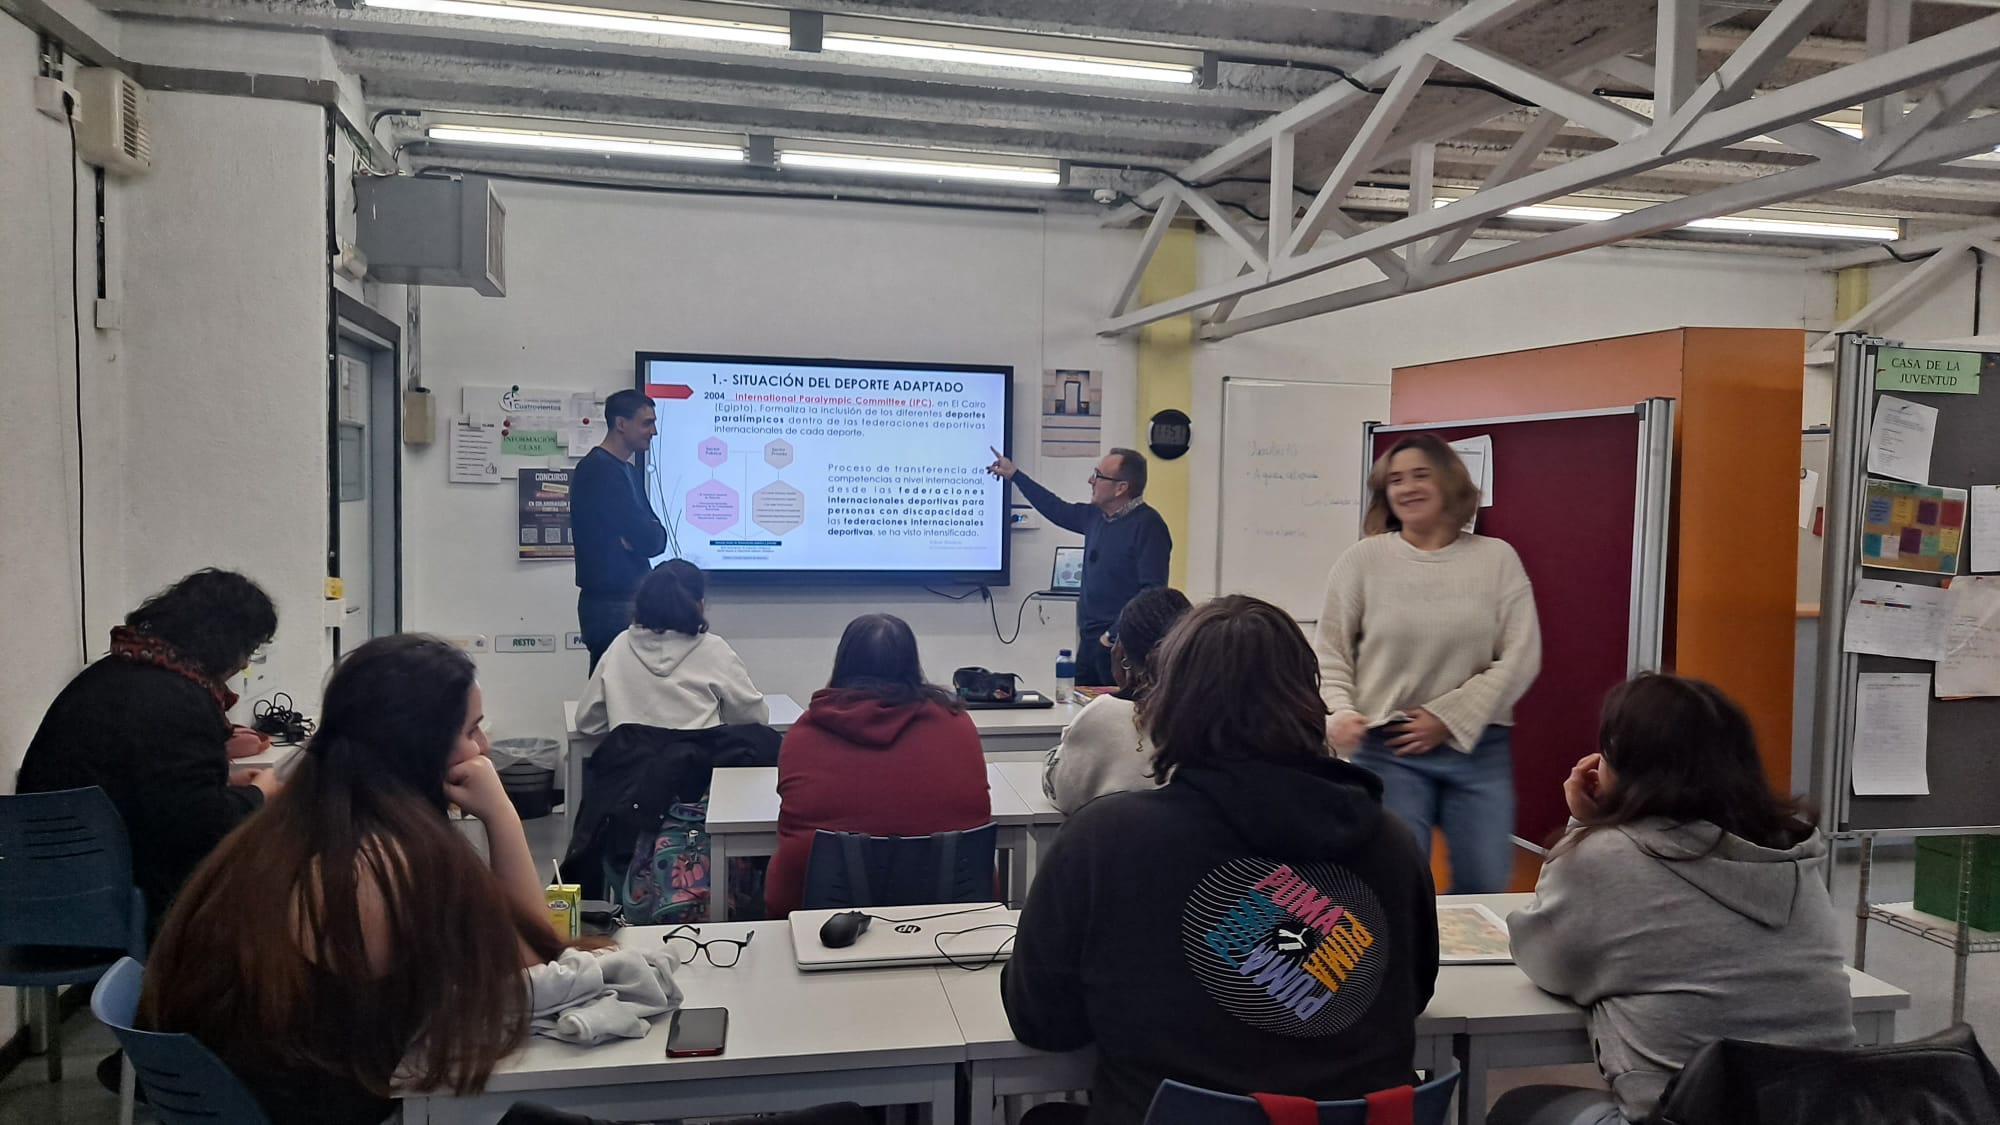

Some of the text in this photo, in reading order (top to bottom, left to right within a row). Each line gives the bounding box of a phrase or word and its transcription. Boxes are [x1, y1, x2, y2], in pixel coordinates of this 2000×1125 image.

[1891, 358, 1960, 372] CASA DE LA
[712, 373, 964, 392] 1.- SITUACIÓN DEL DEPORTE ADAPTADO
[1900, 373, 1958, 386] JUVENTUD
[704, 392, 725, 400] 2004
[736, 393, 796, 402] International
[800, 395, 852, 405] Paralympic
[856, 397, 906, 406] Committee
[962, 400, 986, 408] Cairo
[514, 402, 561, 412] Cuatrovientos
[760, 404, 806, 414] Formaliza
[809, 406, 818, 414] la
[820, 406, 862, 416] inclusión
[865, 408, 878, 416] de
[880, 408, 893, 416] los
[896, 409, 942, 418] diferentes
[945, 410, 986, 420] deportes
[714, 414, 986, 430] paralímpicos dentro de las federaciones deportivas
[714, 424, 865, 438] internacionales de cada deporte.
[828, 464, 984, 474] Proceso de transferencia de
[535, 473, 568, 481] CONCURSO
[828, 474, 892, 484] competencias
[903, 476, 924, 484] nivel
[828, 486, 984, 496] desde las federaciones
[828, 496, 984, 507] internacionales deportivas para
[828, 508, 875, 516] personas
[903, 508, 974, 517] discapacidad
[828, 517, 984, 528] las federaciones internacionales
[890, 529, 900, 537] ha
[903, 529, 922, 538] visto
[512, 638, 536, 646] RESTO
[1254, 864, 1346, 936] PUMA
[1204, 890, 1286, 968] PUMA
[1302, 911, 1374, 993] PUMA
[1239, 943, 1333, 1020] PUMA
